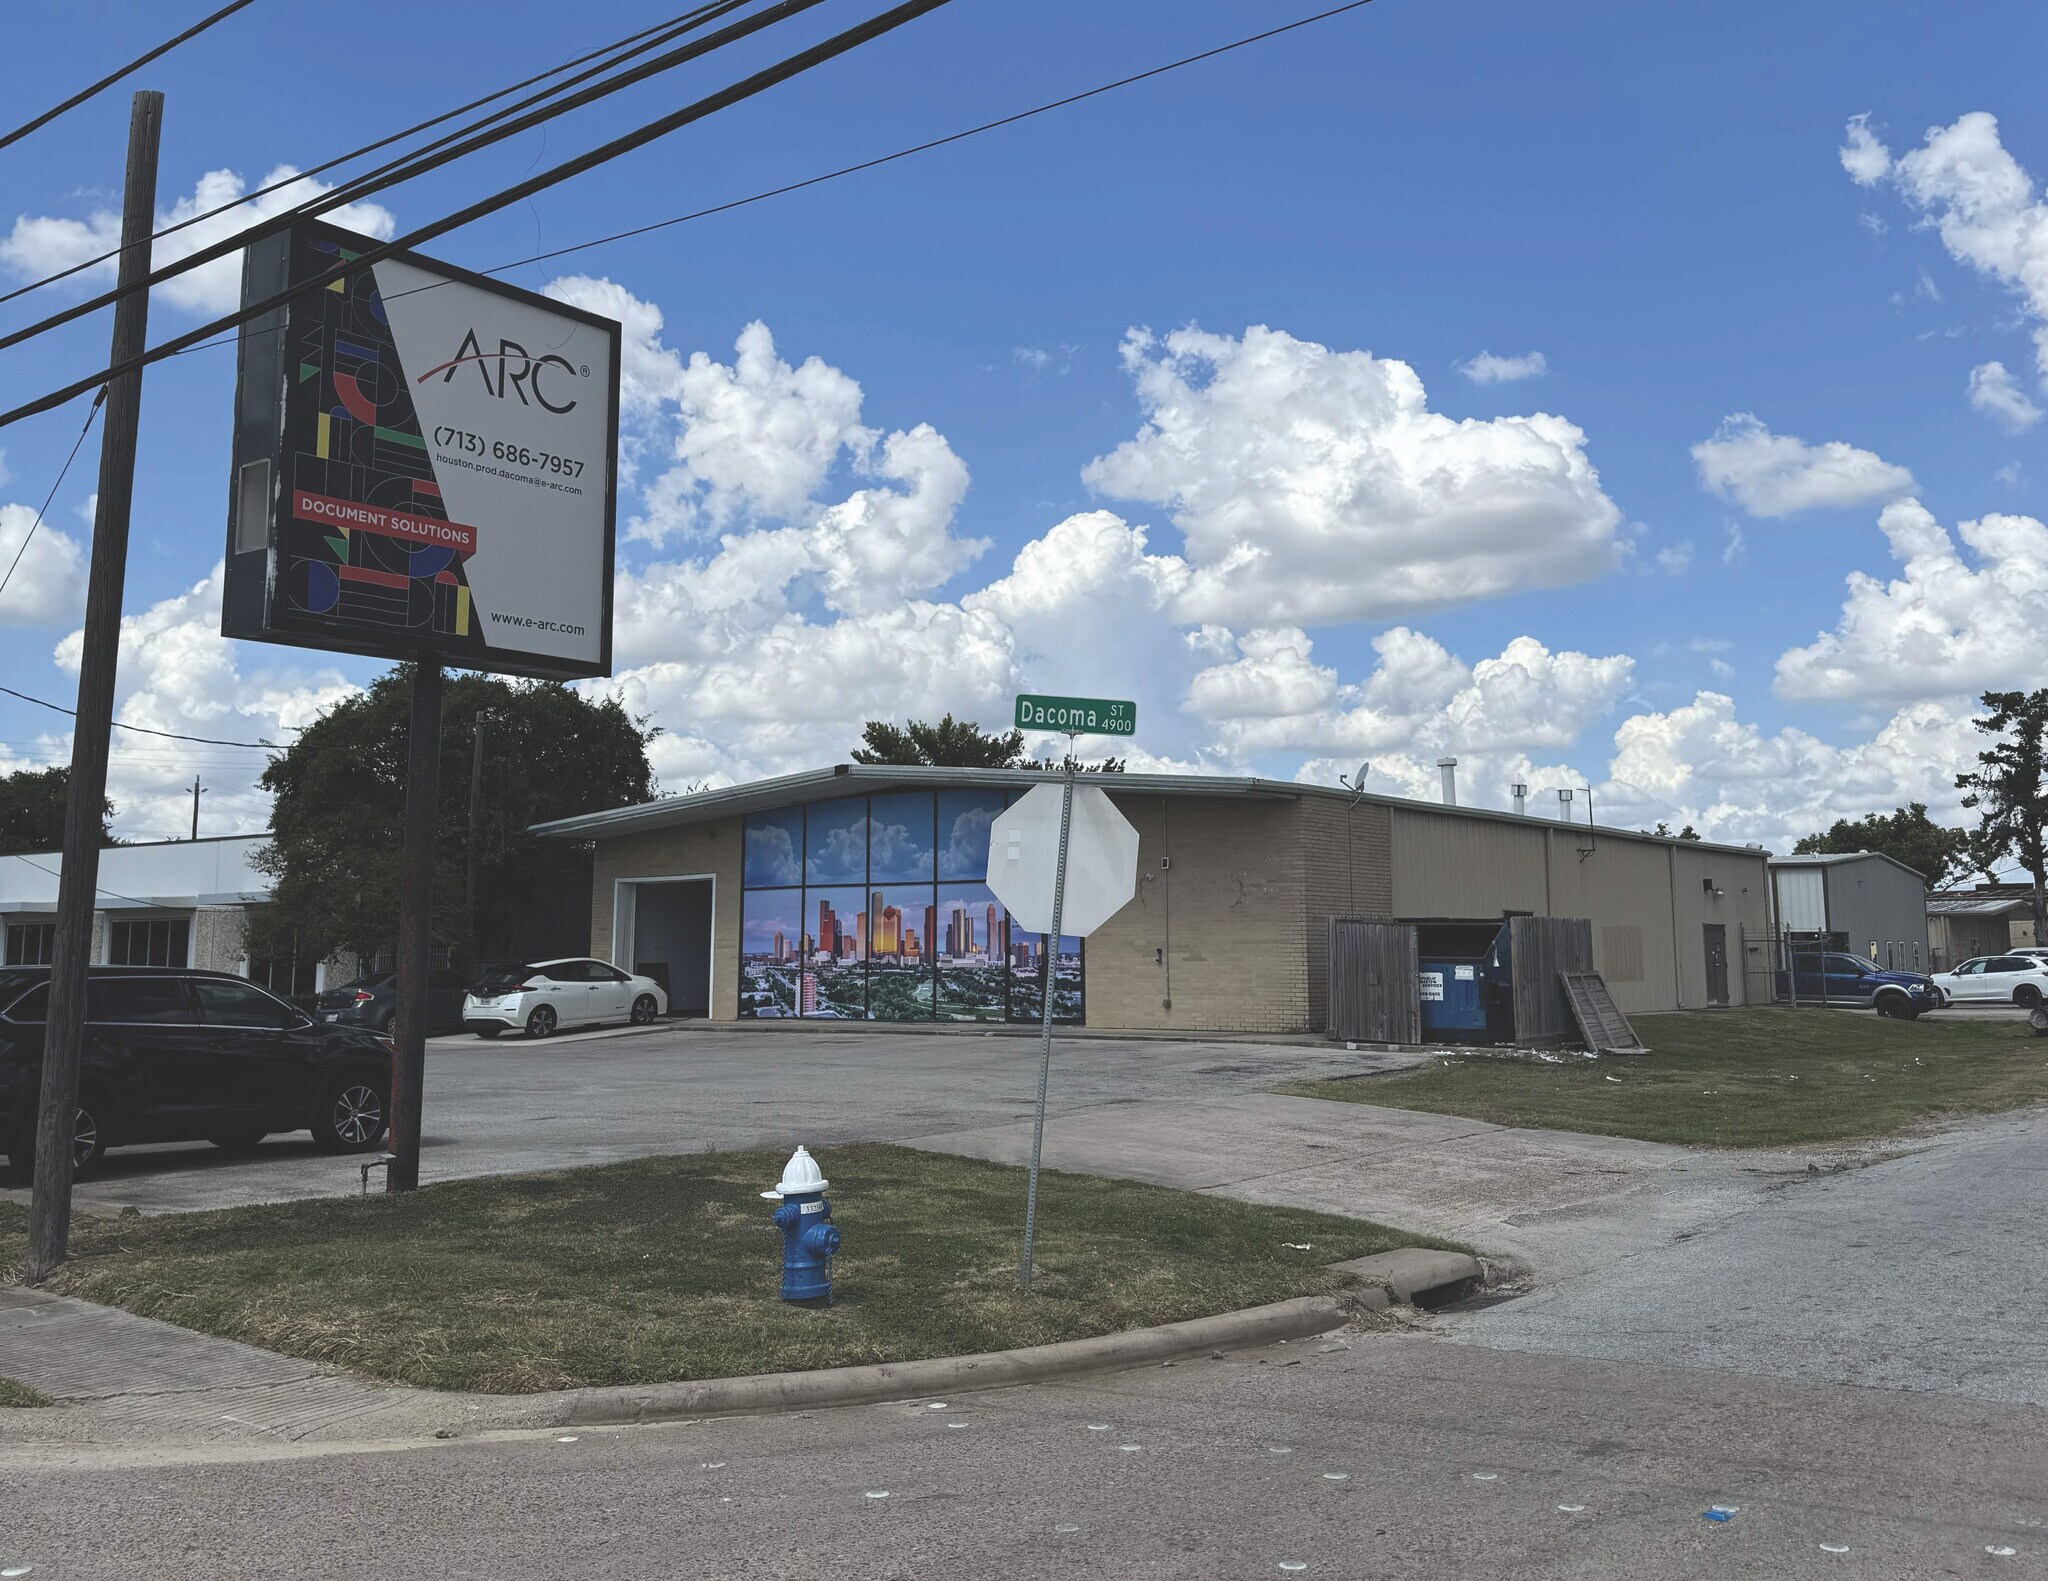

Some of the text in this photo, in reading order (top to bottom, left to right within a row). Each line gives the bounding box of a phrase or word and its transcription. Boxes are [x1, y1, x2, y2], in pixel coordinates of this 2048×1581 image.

[433, 425, 585, 478] (713) 686-7957
[436, 452, 583, 496] houston.prod.dacoma@e-arc.com
[302, 498, 470, 544] DOCUMENT SOLUTIONS
[491, 612, 585, 636] www.e-arc.com
[1021, 701, 1125, 727] Dacoma ST
[1101, 719, 1132, 732] 4900
